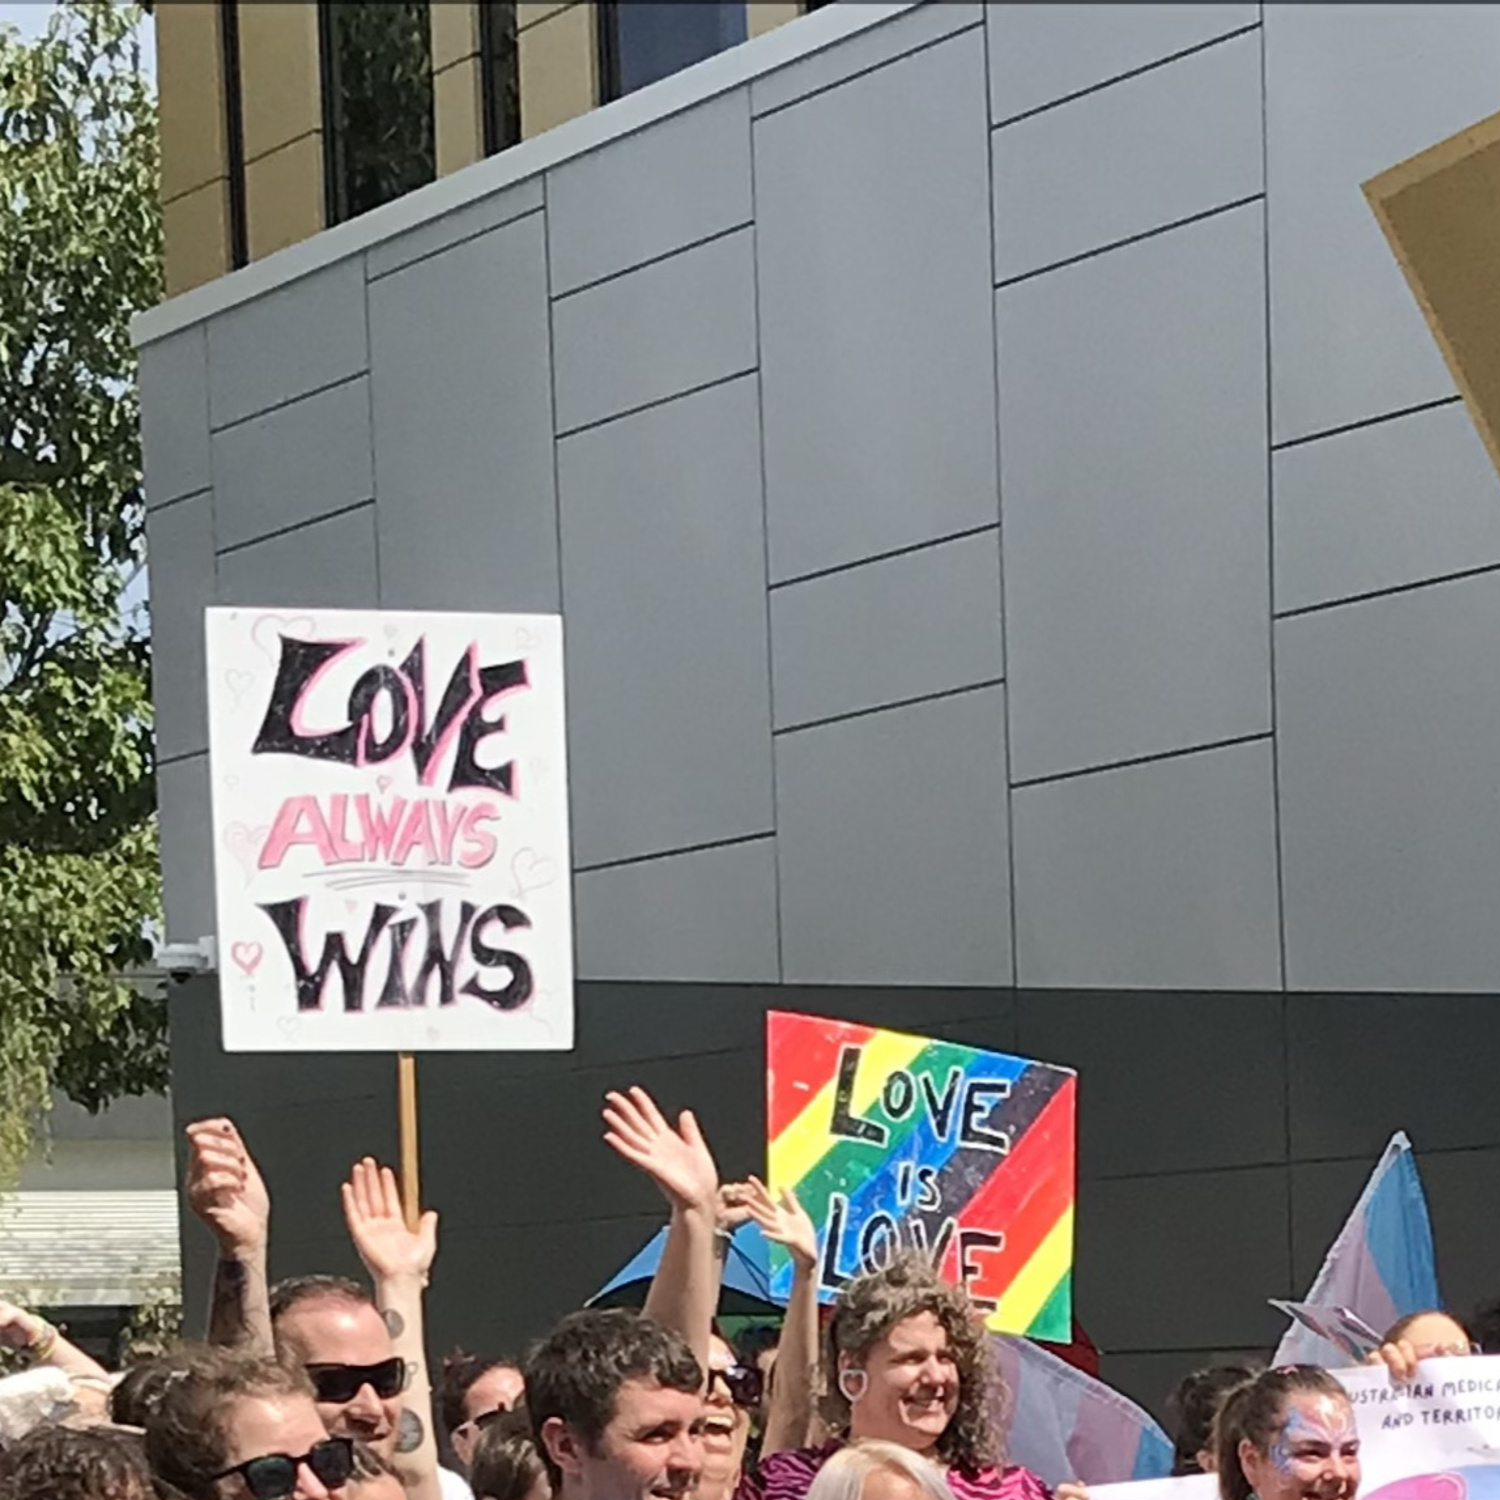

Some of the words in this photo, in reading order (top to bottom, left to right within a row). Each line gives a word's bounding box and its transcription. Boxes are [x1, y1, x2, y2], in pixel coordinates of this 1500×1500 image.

[251, 633, 531, 799] LOVE
[257, 792, 501, 870] ALWAYS
[255, 895, 534, 1014] WINS
[829, 1043, 1012, 1154] LOVE
[898, 1161, 942, 1211] IS
[1381, 1412, 1415, 1430] AND
